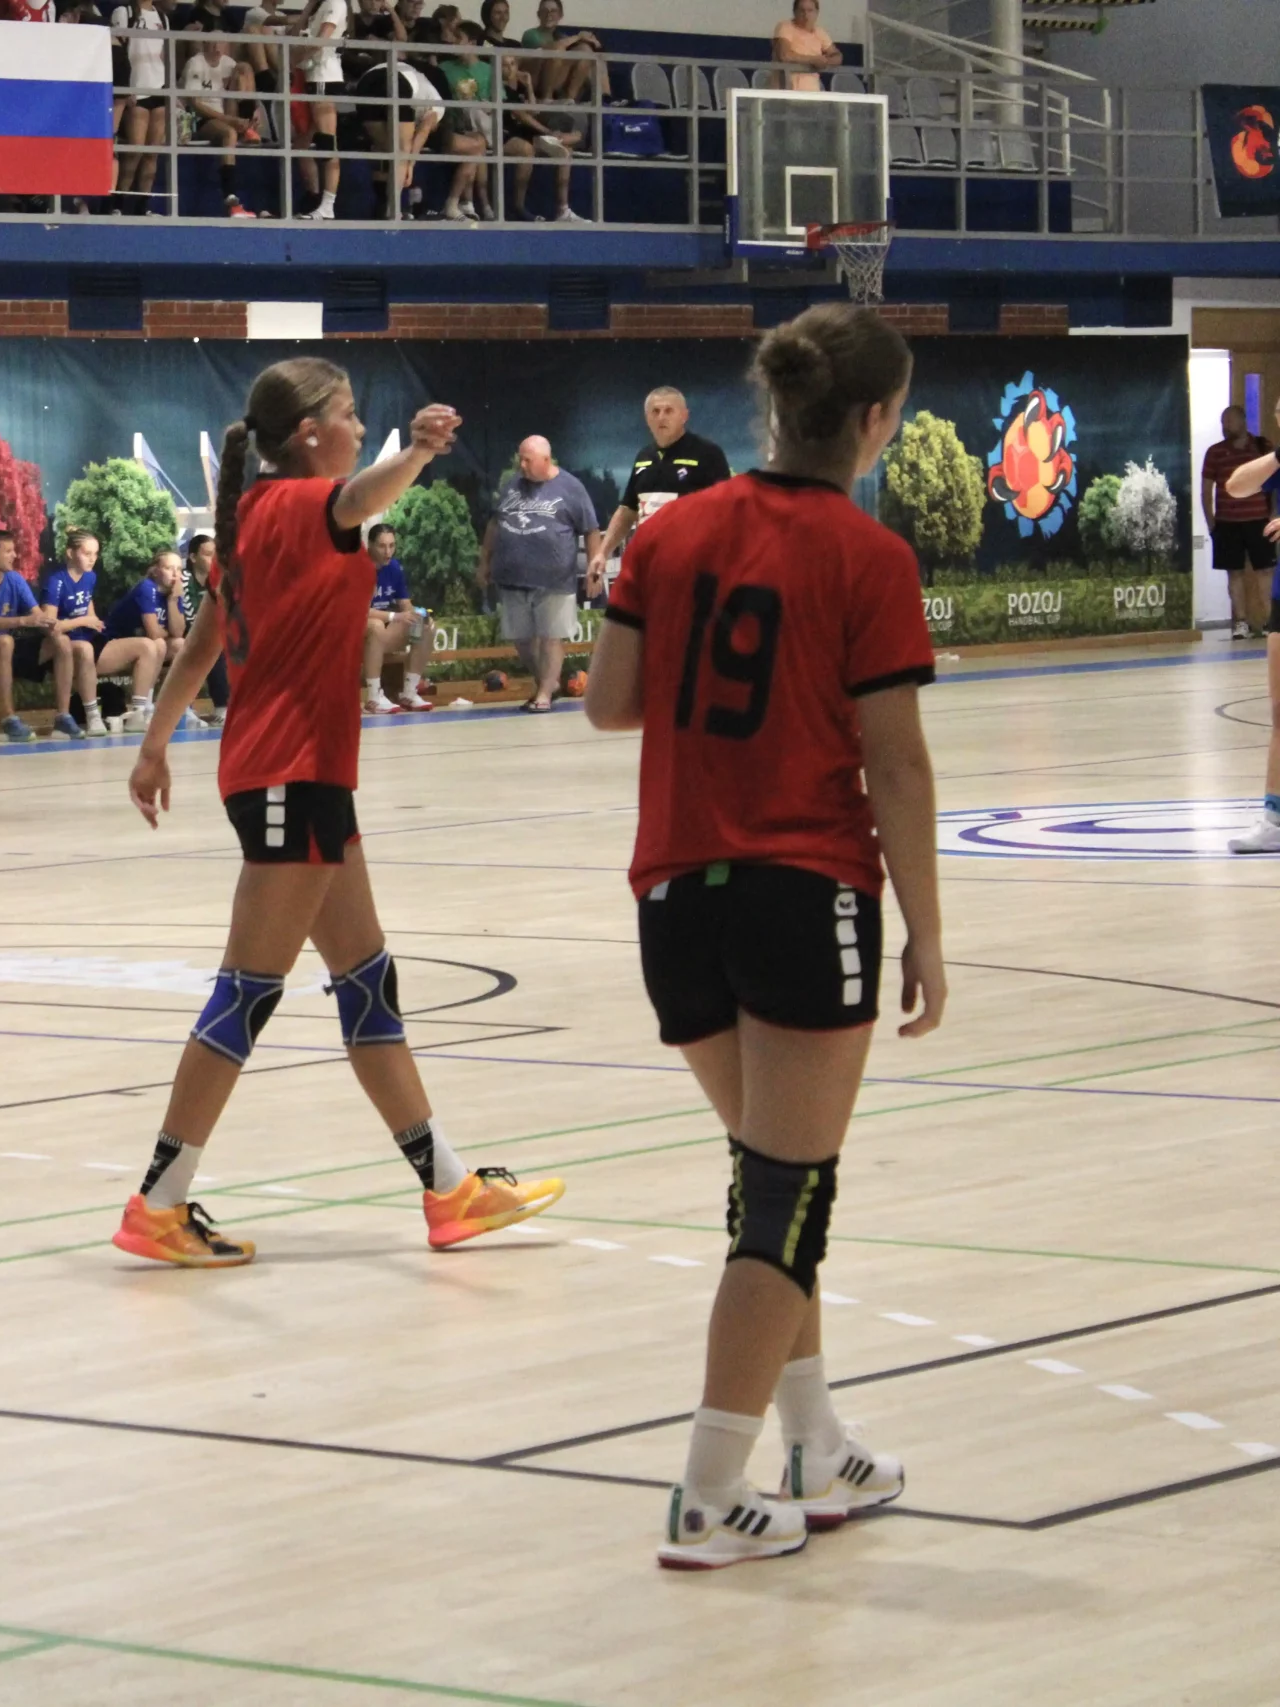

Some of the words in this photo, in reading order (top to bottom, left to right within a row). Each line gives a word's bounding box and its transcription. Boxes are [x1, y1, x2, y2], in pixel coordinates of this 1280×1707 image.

[1007, 590, 1063, 616] POZOJ
[1113, 583, 1167, 609] POZOJ
[674, 570, 783, 741] 19
